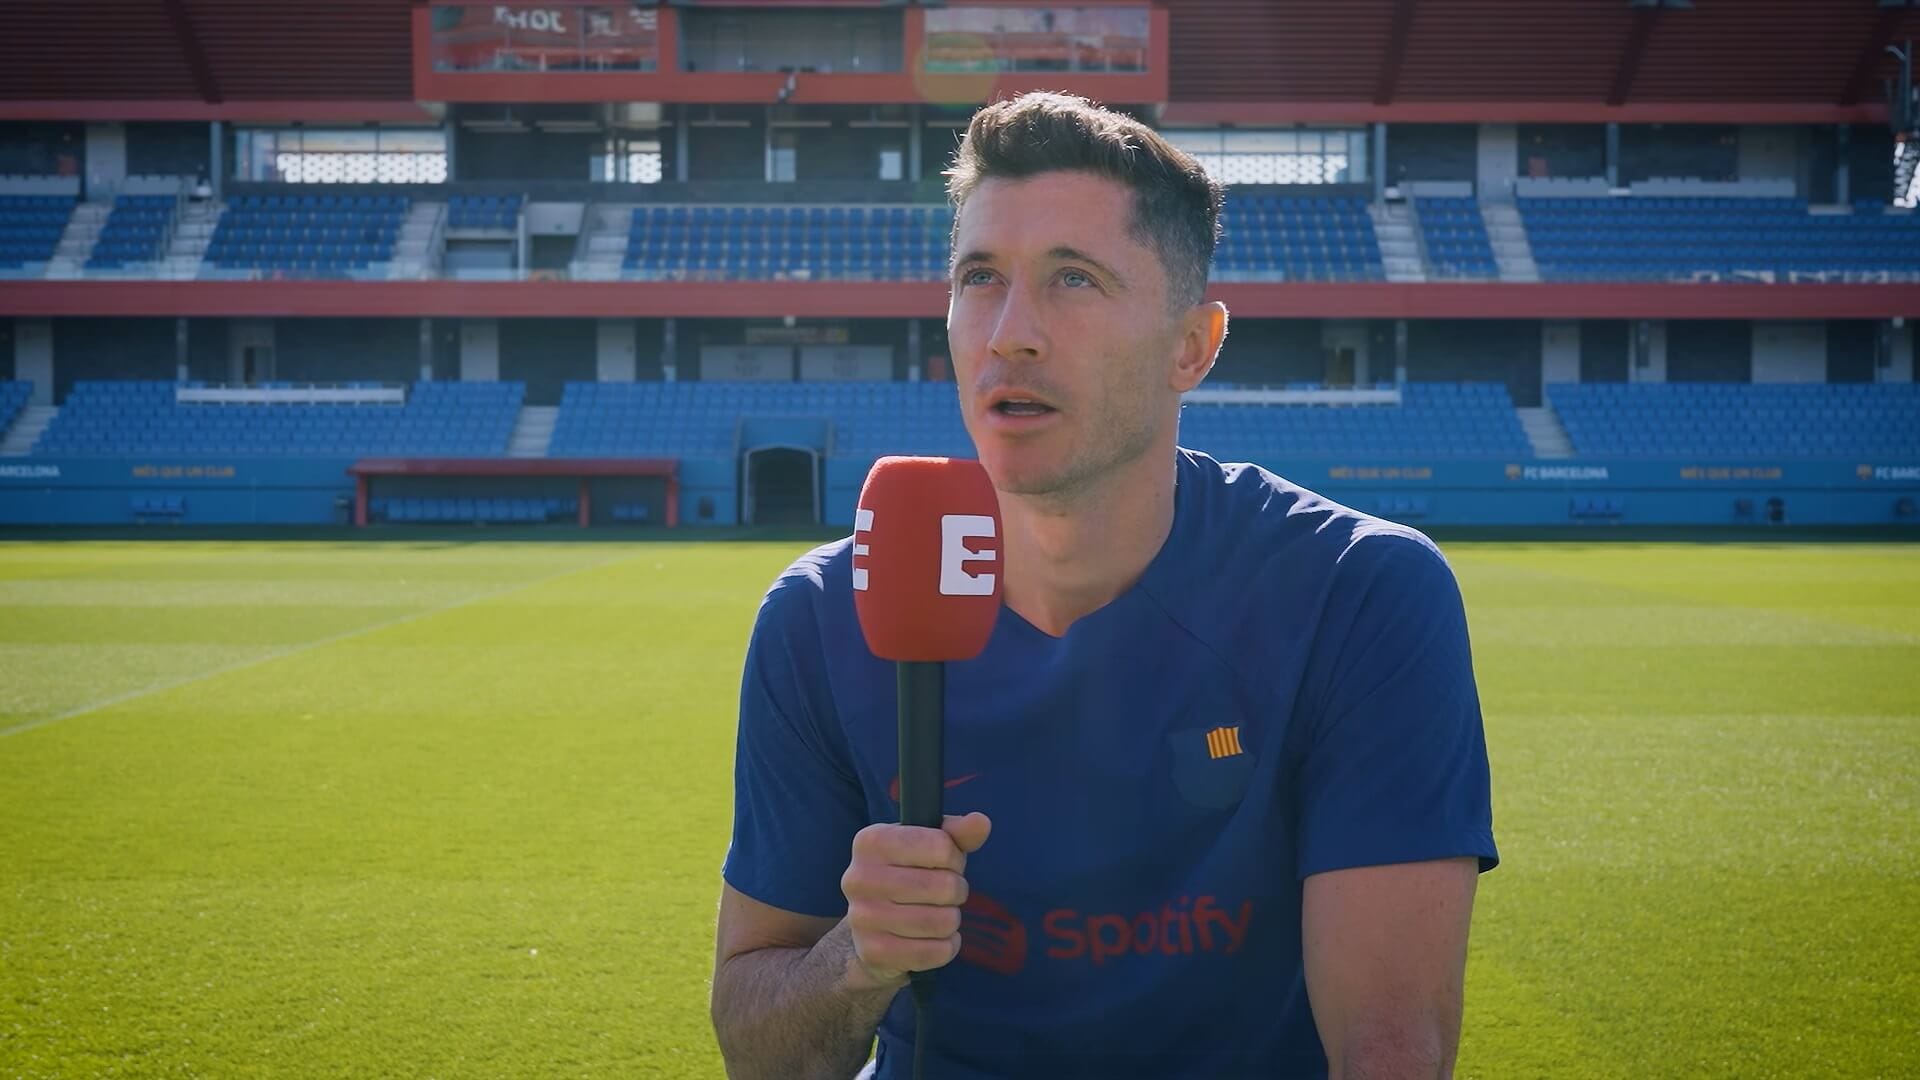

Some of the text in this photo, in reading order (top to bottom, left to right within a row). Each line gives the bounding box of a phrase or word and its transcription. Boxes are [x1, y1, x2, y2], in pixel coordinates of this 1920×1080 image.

[1523, 465, 1607, 479] FC BARCELONA
[939, 514, 996, 596] E
[1043, 895, 1252, 966] Spotify
